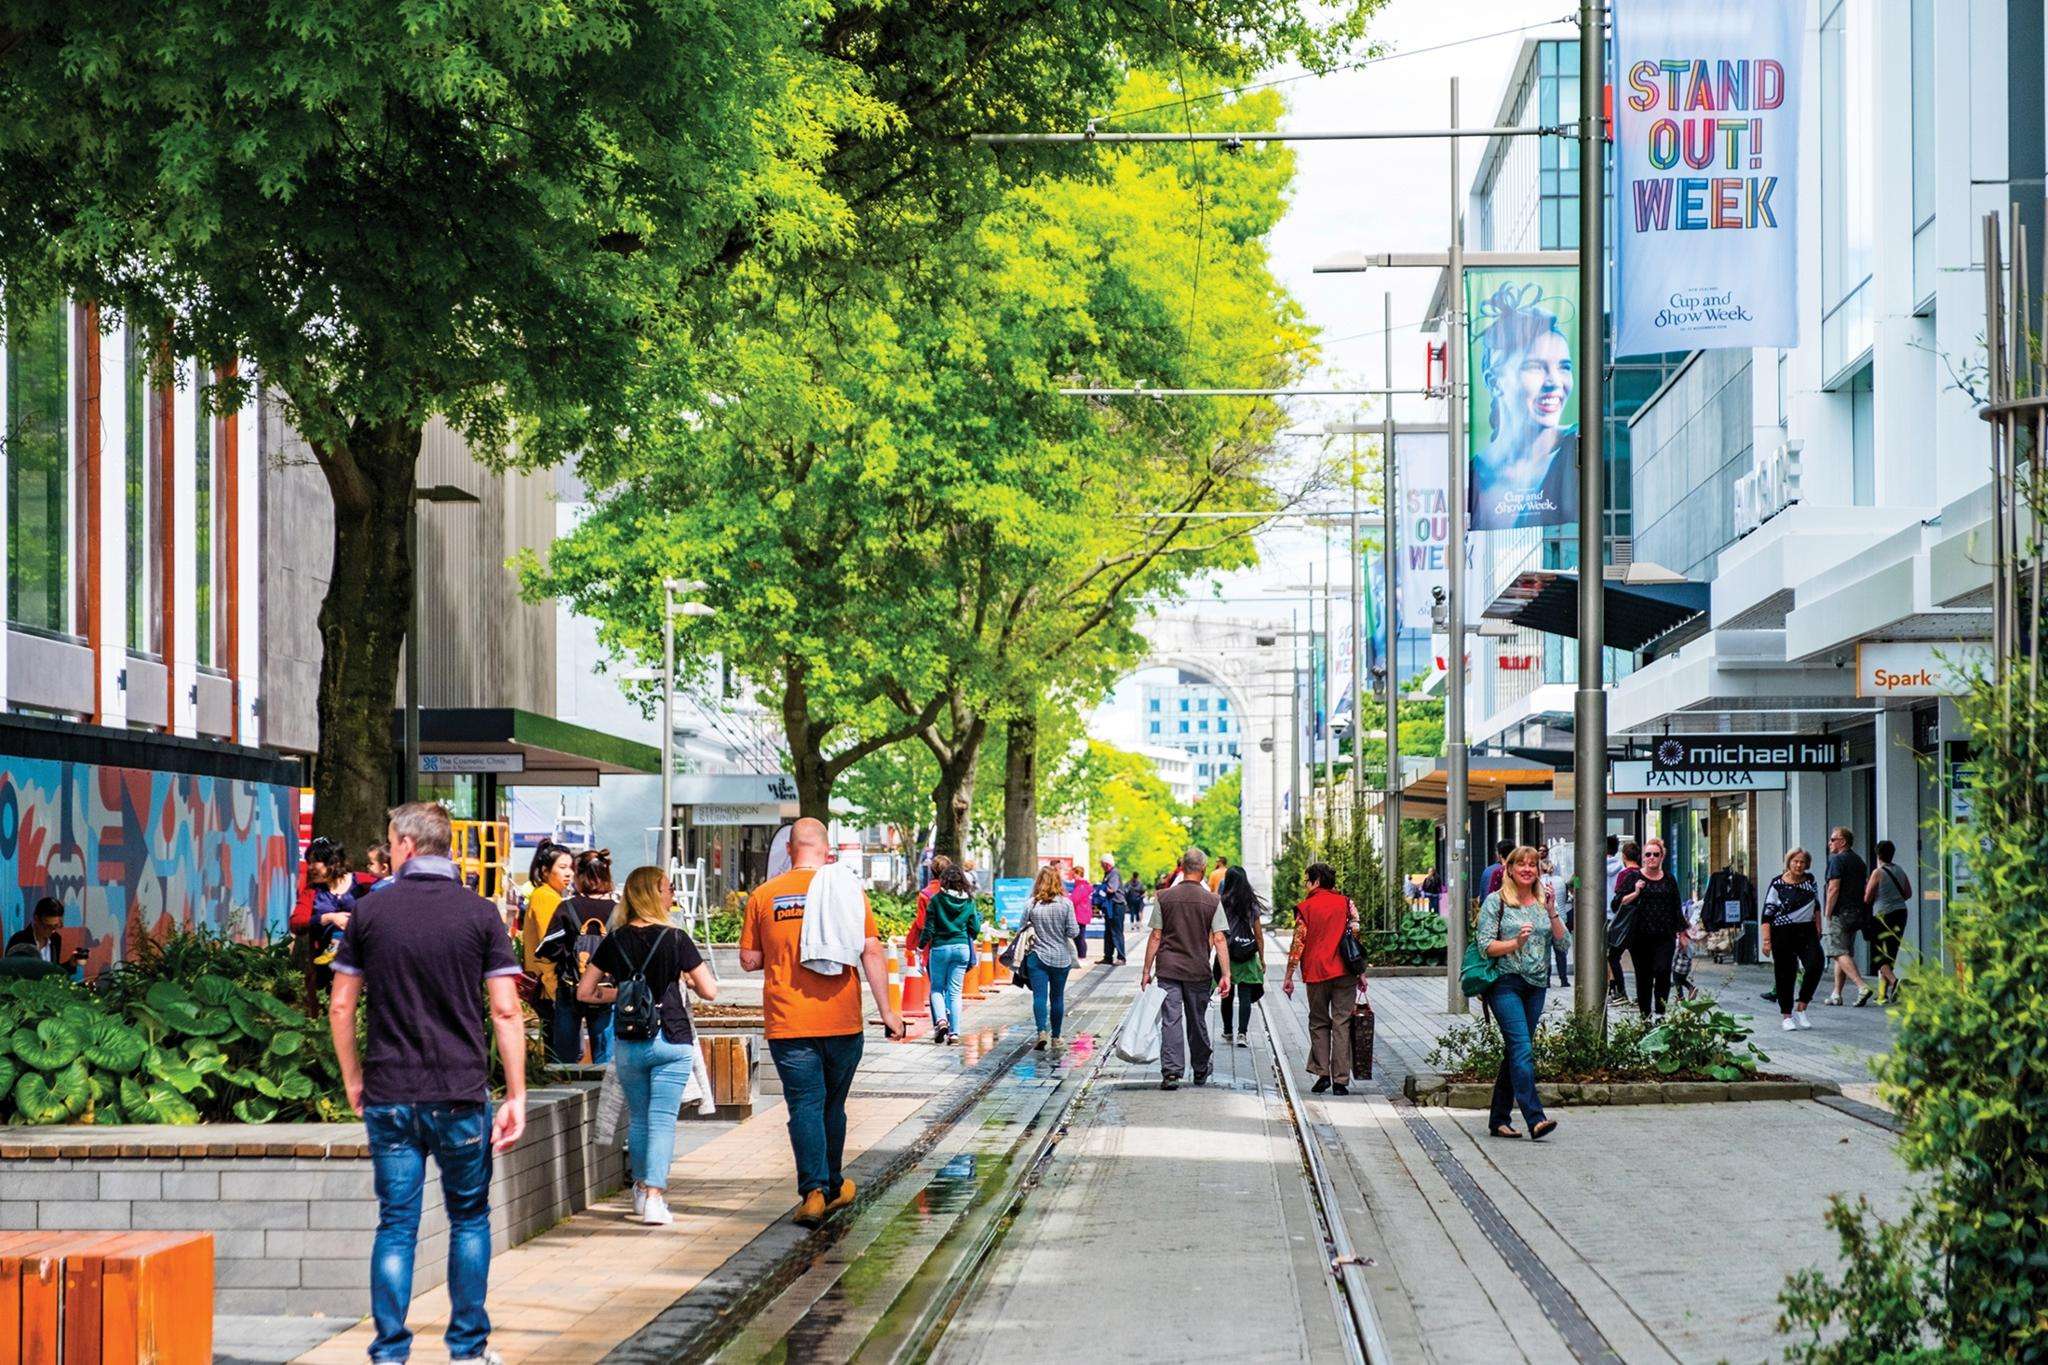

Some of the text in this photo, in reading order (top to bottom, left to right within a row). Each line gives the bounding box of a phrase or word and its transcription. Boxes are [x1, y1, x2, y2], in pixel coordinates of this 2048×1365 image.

[1628, 59, 1785, 112] STAND
[1648, 118, 1762, 170] OUT!
[1632, 176, 1778, 233] WEEK
[1670, 291, 1733, 310] Cup and
[1654, 305, 1754, 328] Show Week
[1504, 491, 1525, 504] Cup
[1527, 499, 1557, 511] Week
[1874, 668, 1932, 690] Spark
[1690, 744, 1836, 764] michael hill
[1646, 771, 1753, 786] PANDORA
